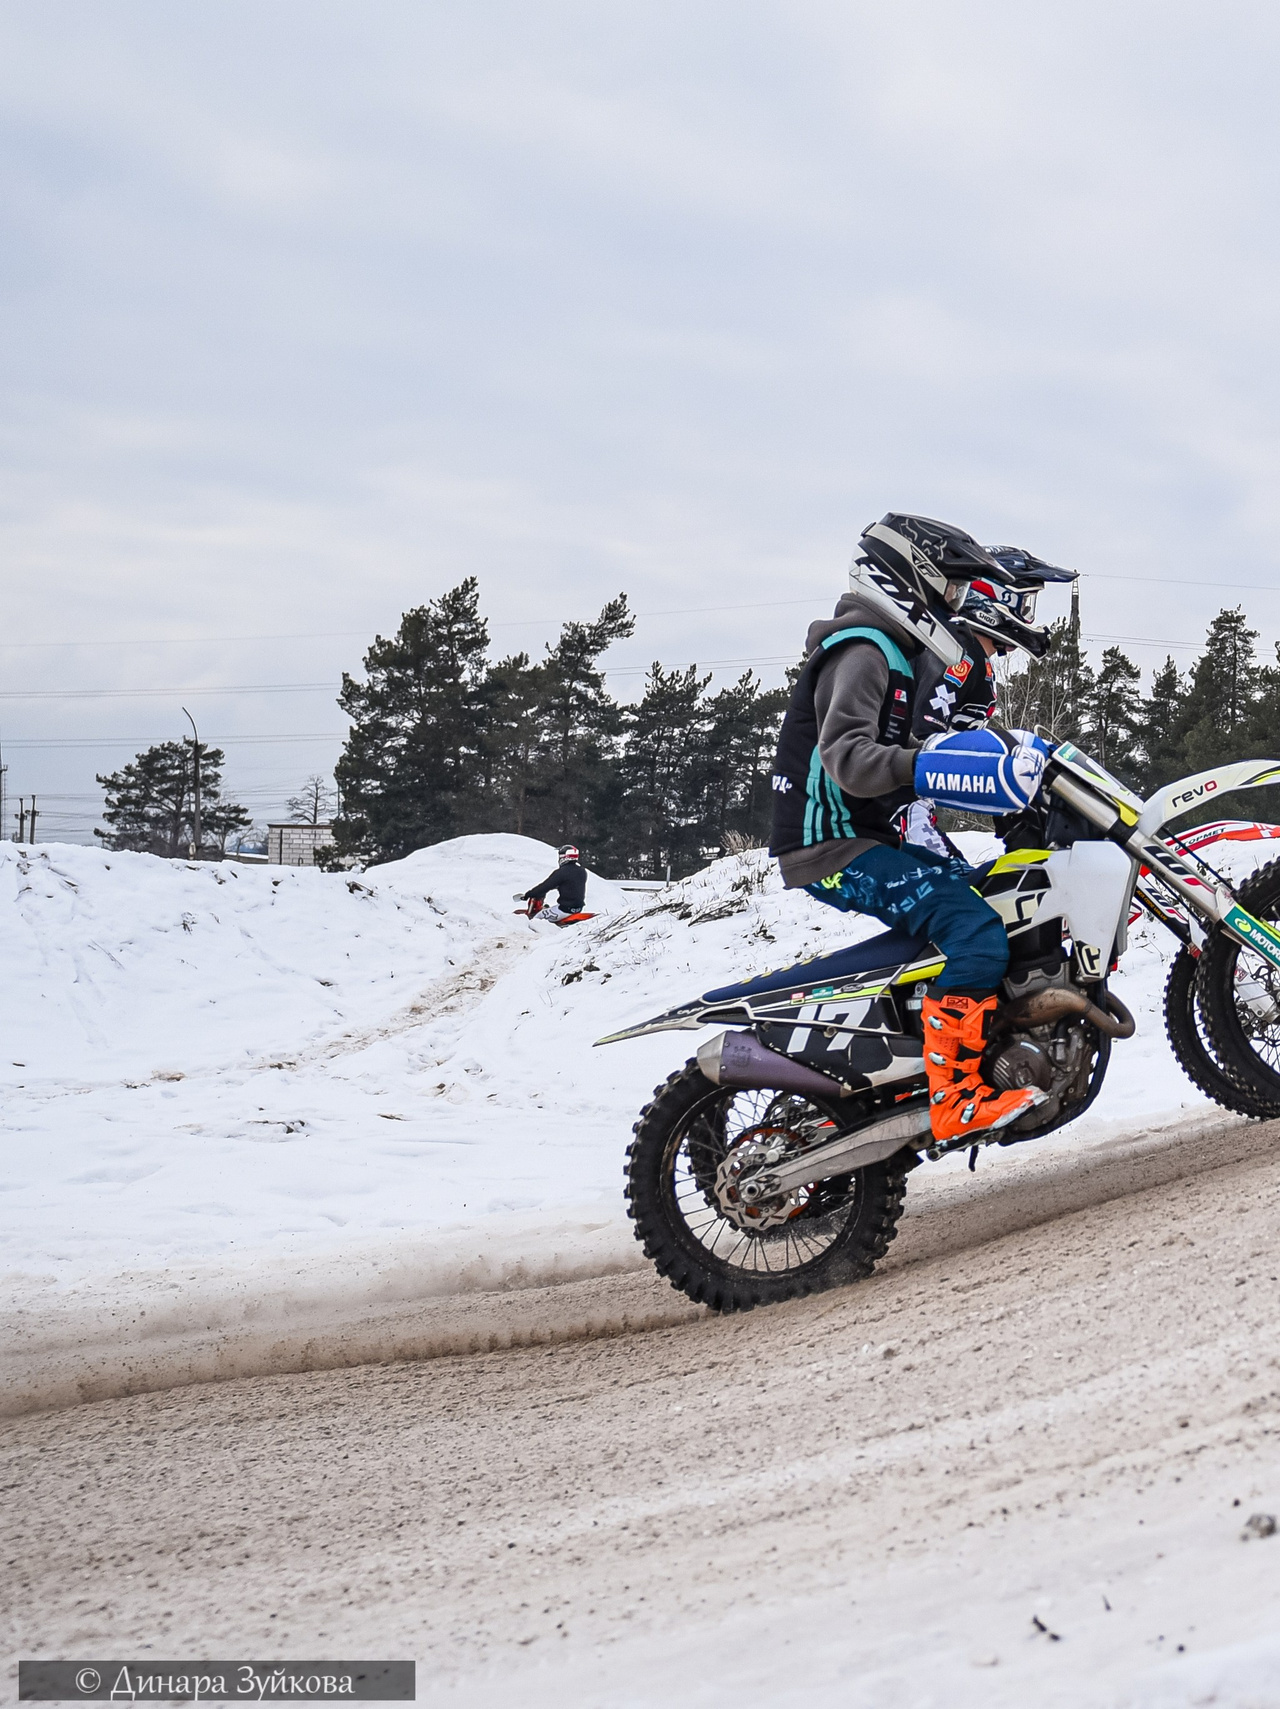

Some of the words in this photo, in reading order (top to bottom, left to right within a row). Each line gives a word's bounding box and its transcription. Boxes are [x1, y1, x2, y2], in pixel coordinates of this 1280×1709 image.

[978, 612, 996, 625] SHOEI
[925, 771, 997, 794] YAMAHA
[1171, 779, 1218, 808] revo
[786, 999, 872, 1053] 17
